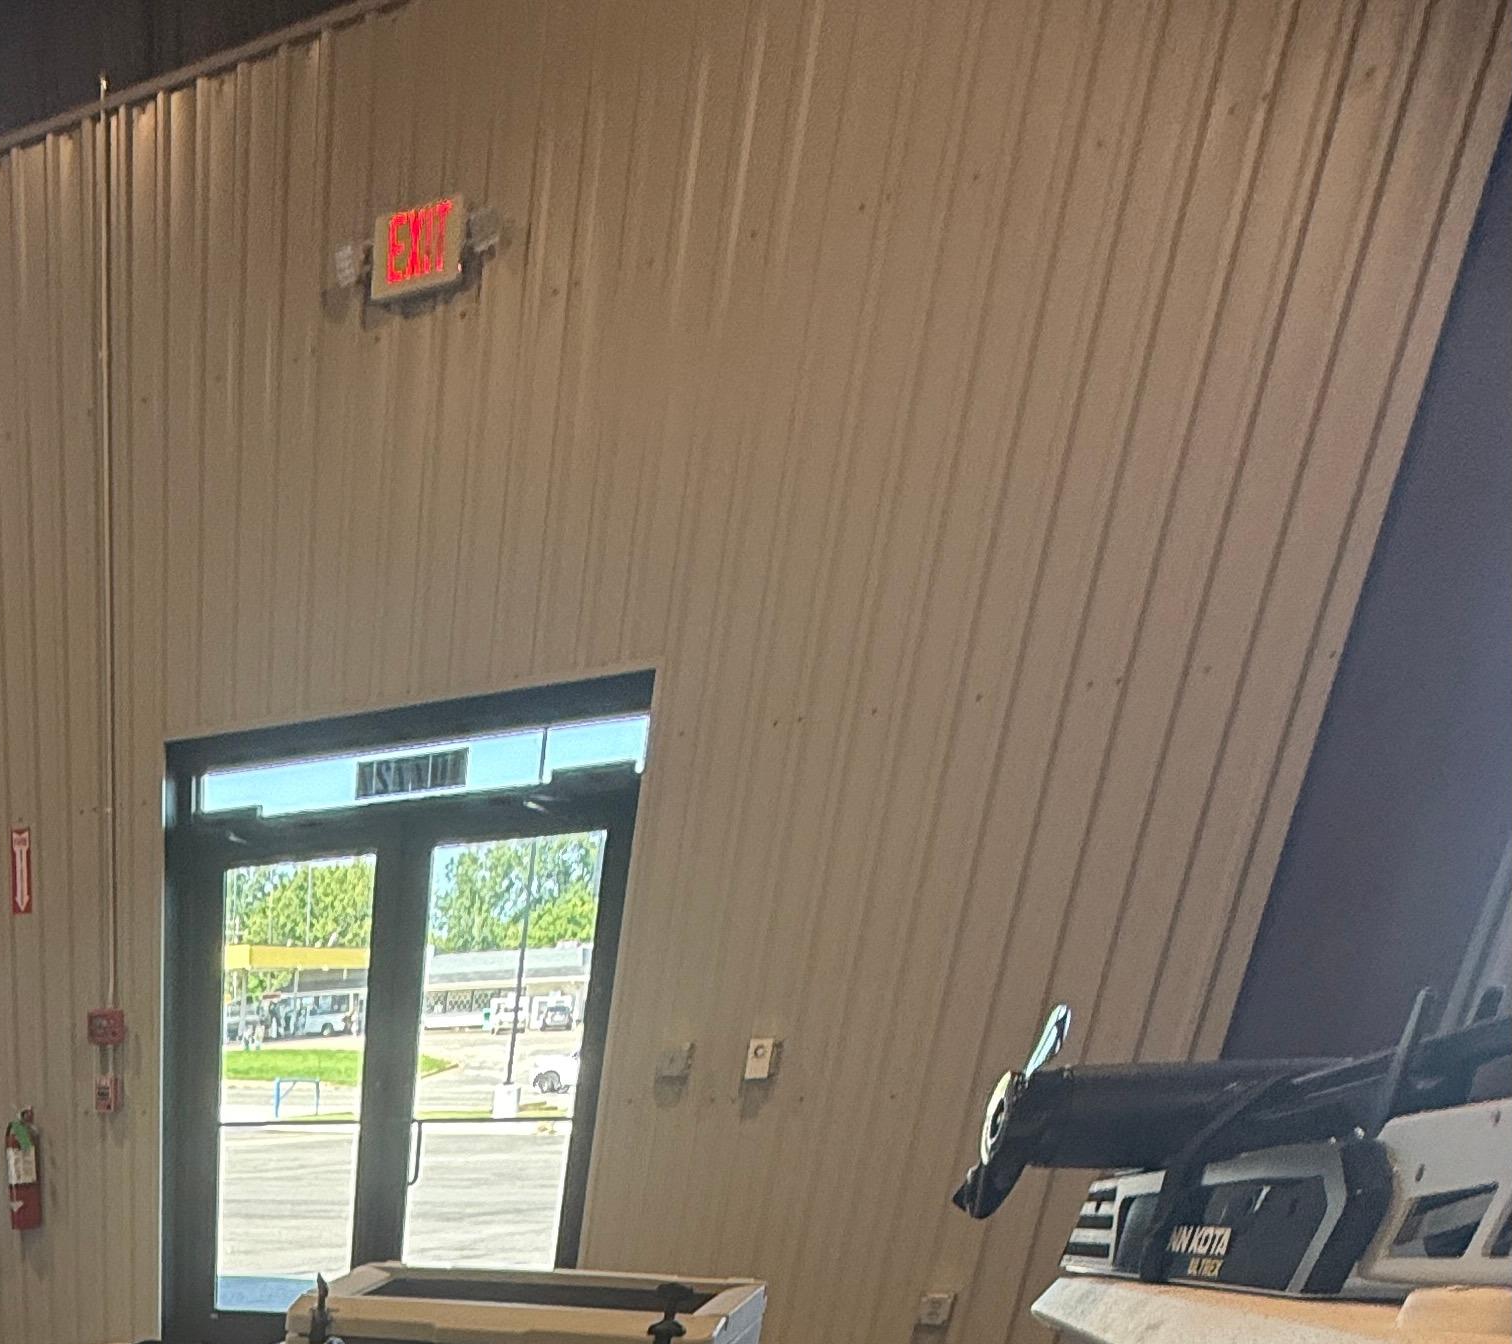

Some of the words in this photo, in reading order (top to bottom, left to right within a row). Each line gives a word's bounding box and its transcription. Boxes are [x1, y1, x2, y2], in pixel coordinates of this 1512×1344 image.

[386, 199, 453, 284] EXIT
[1166, 1225, 1193, 1253] NN
[1187, 1225, 1232, 1256] KOTA
